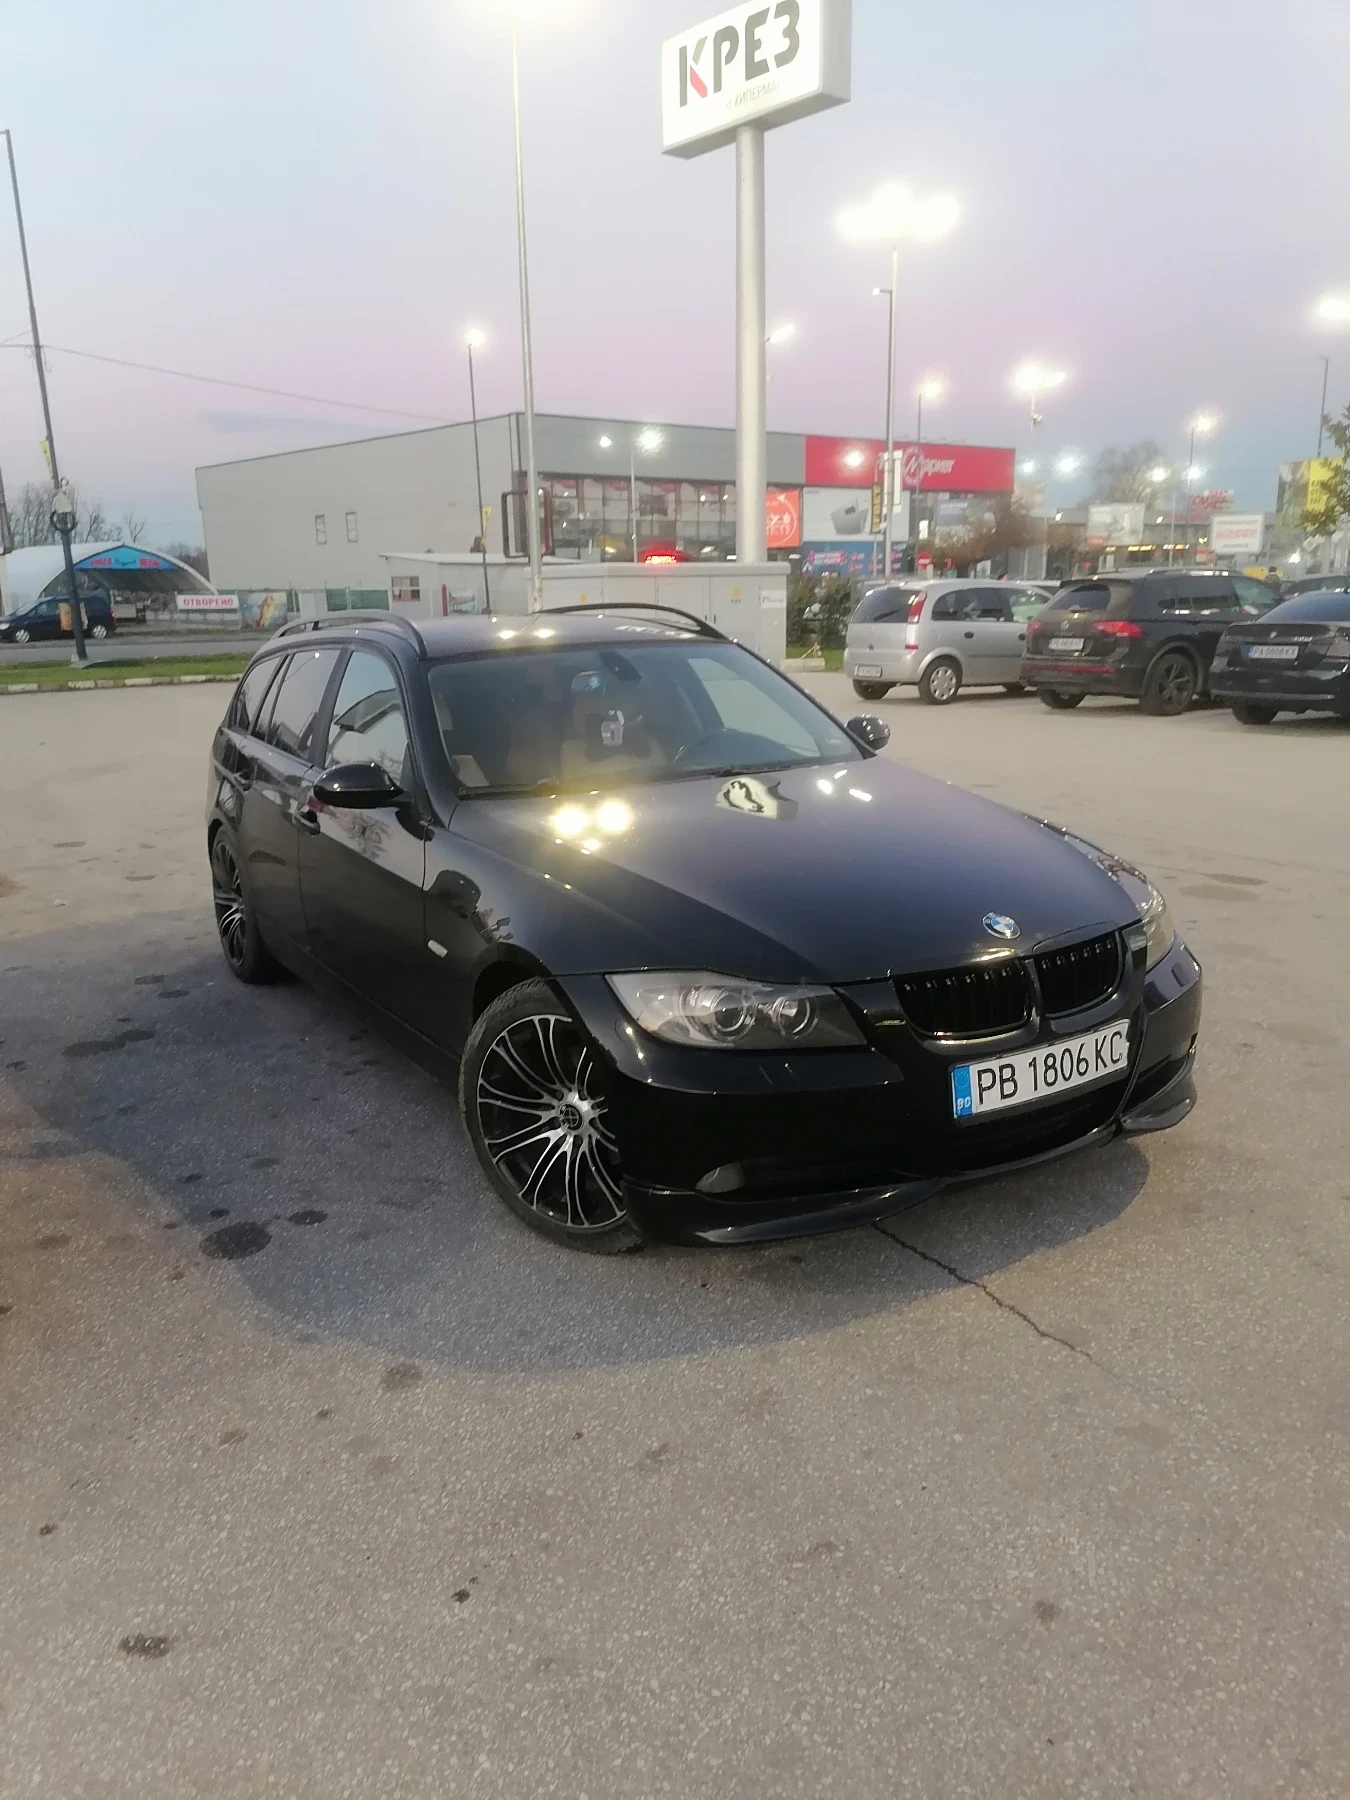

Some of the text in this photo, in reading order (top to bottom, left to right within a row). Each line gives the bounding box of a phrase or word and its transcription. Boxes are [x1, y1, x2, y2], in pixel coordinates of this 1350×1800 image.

[734, 80, 780, 108] ХИПЕРМА
[977, 1030, 1123, 1106] PB 1806 KC
